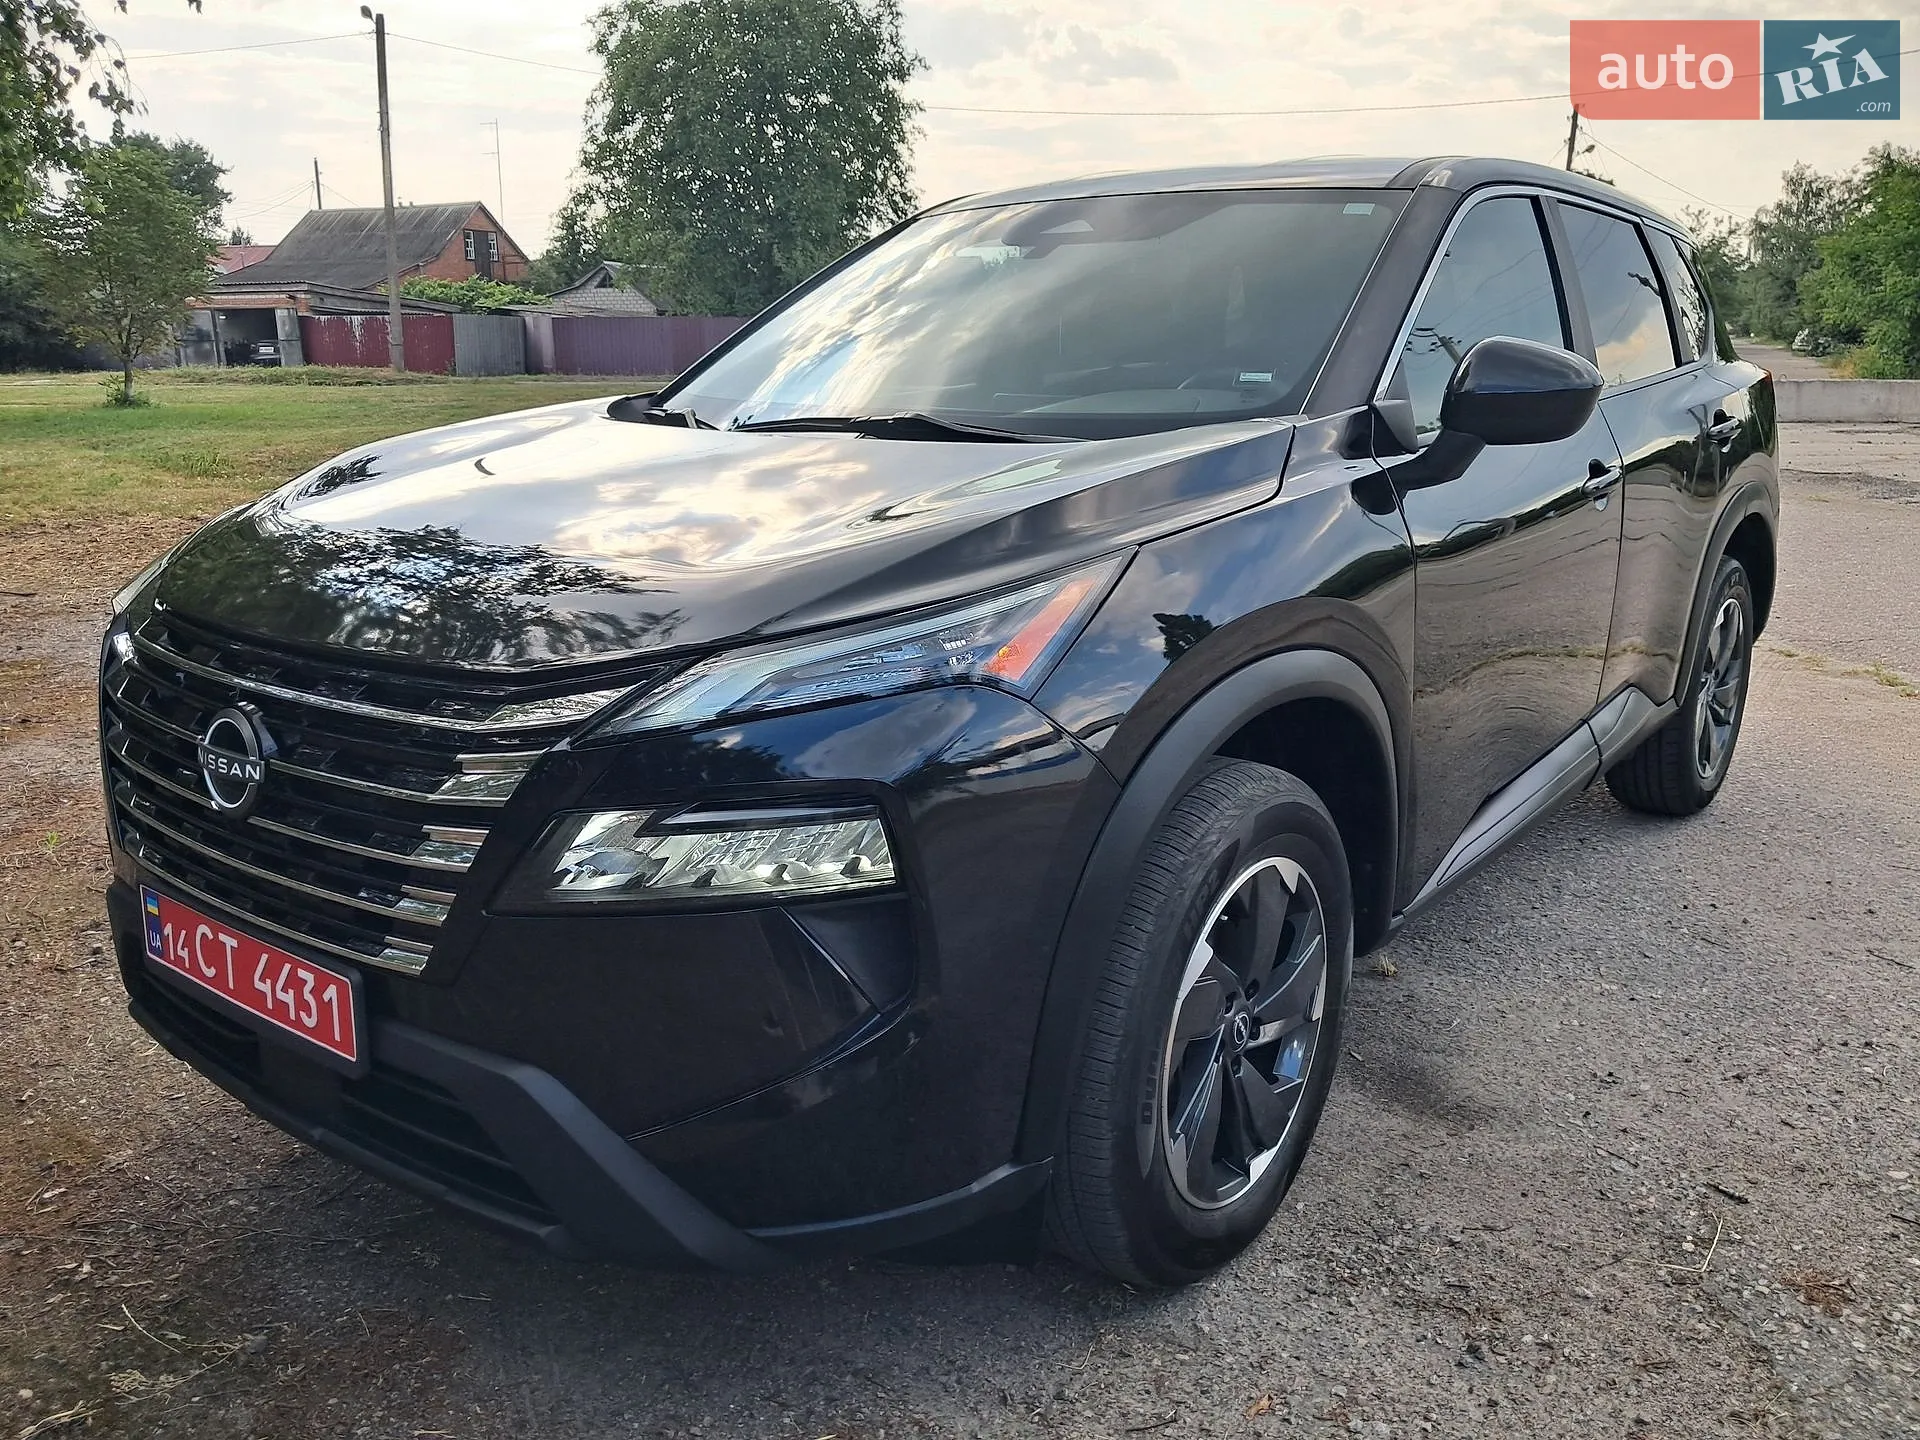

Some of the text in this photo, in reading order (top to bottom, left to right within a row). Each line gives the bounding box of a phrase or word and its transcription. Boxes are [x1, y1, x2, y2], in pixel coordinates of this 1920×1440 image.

[198, 747, 260, 780] NISSAN
[149, 929, 163, 951] UA
[253, 952, 341, 1042] 4431
